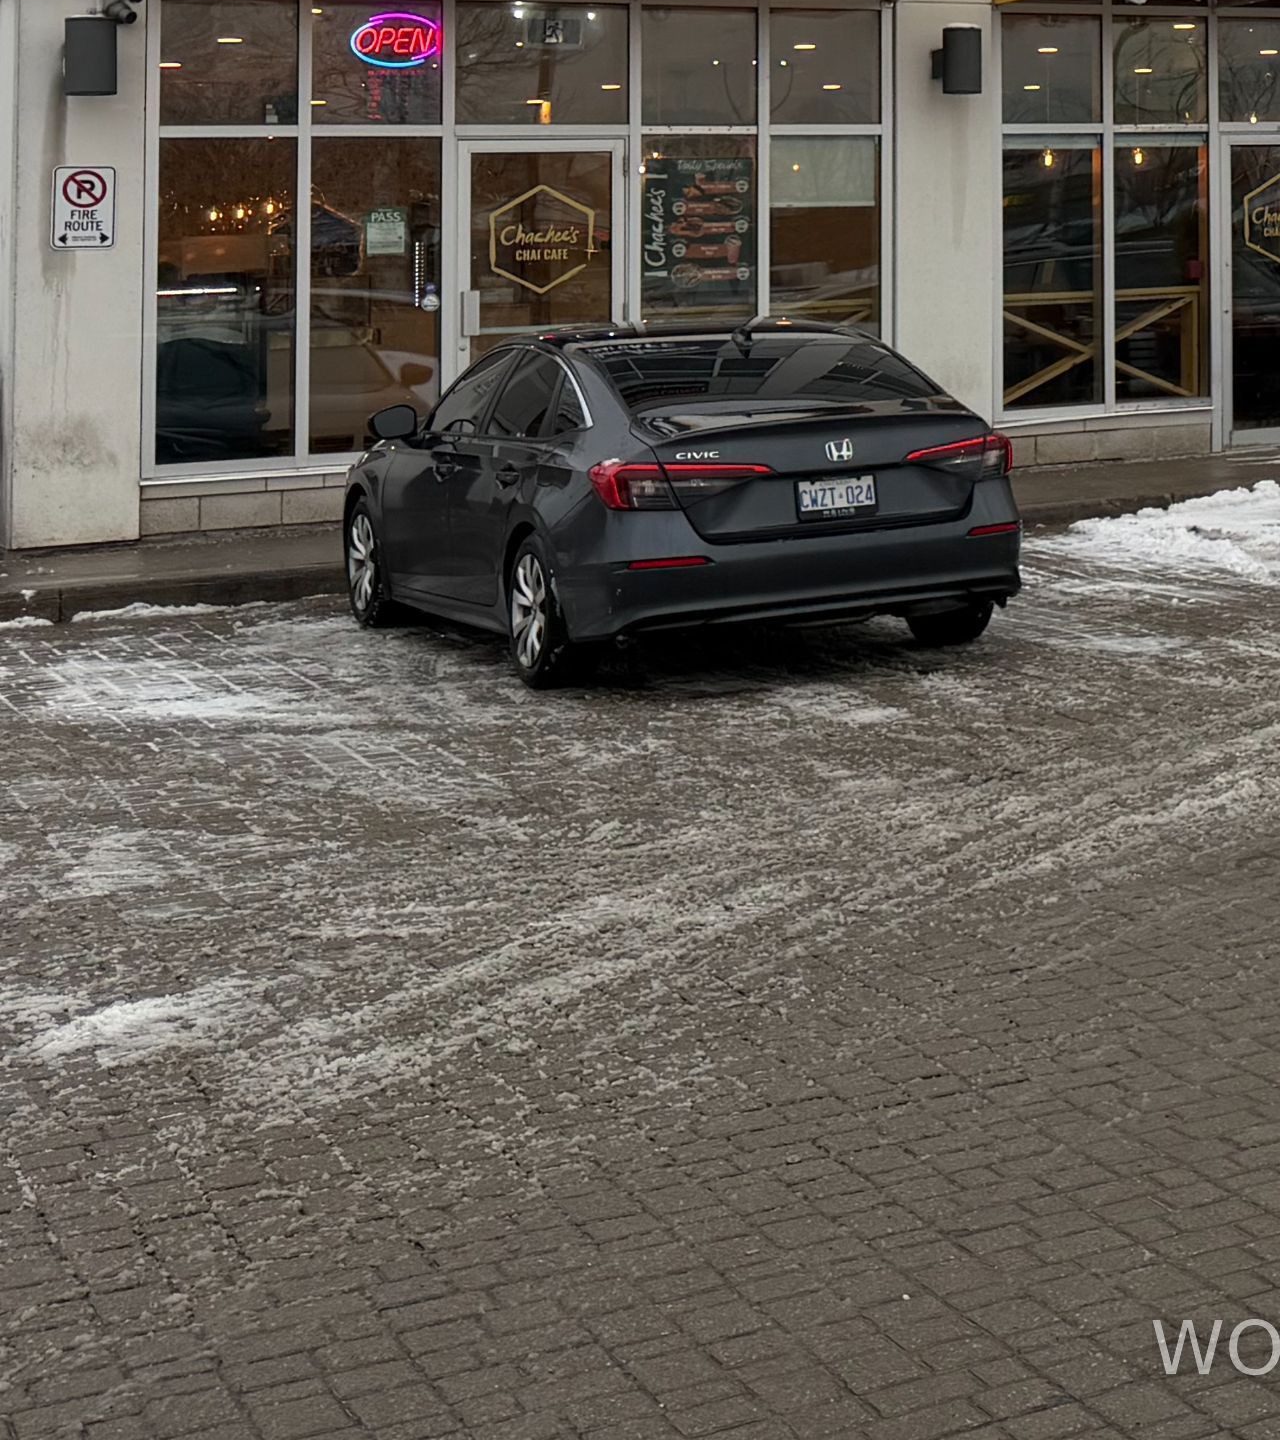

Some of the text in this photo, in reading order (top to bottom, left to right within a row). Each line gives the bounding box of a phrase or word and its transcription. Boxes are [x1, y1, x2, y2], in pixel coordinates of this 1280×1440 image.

[355, 27, 434, 54] OPEN
[70, 209, 98, 220] FIRE
[370, 210, 401, 223] PASS
[64, 220, 104, 232] ROUTE
[643, 187, 667, 268] Chachee's
[500, 223, 581, 245] Chachee's
[515, 248, 569, 261] CHAI CAFE
[675, 450, 721, 461] CIVIC
